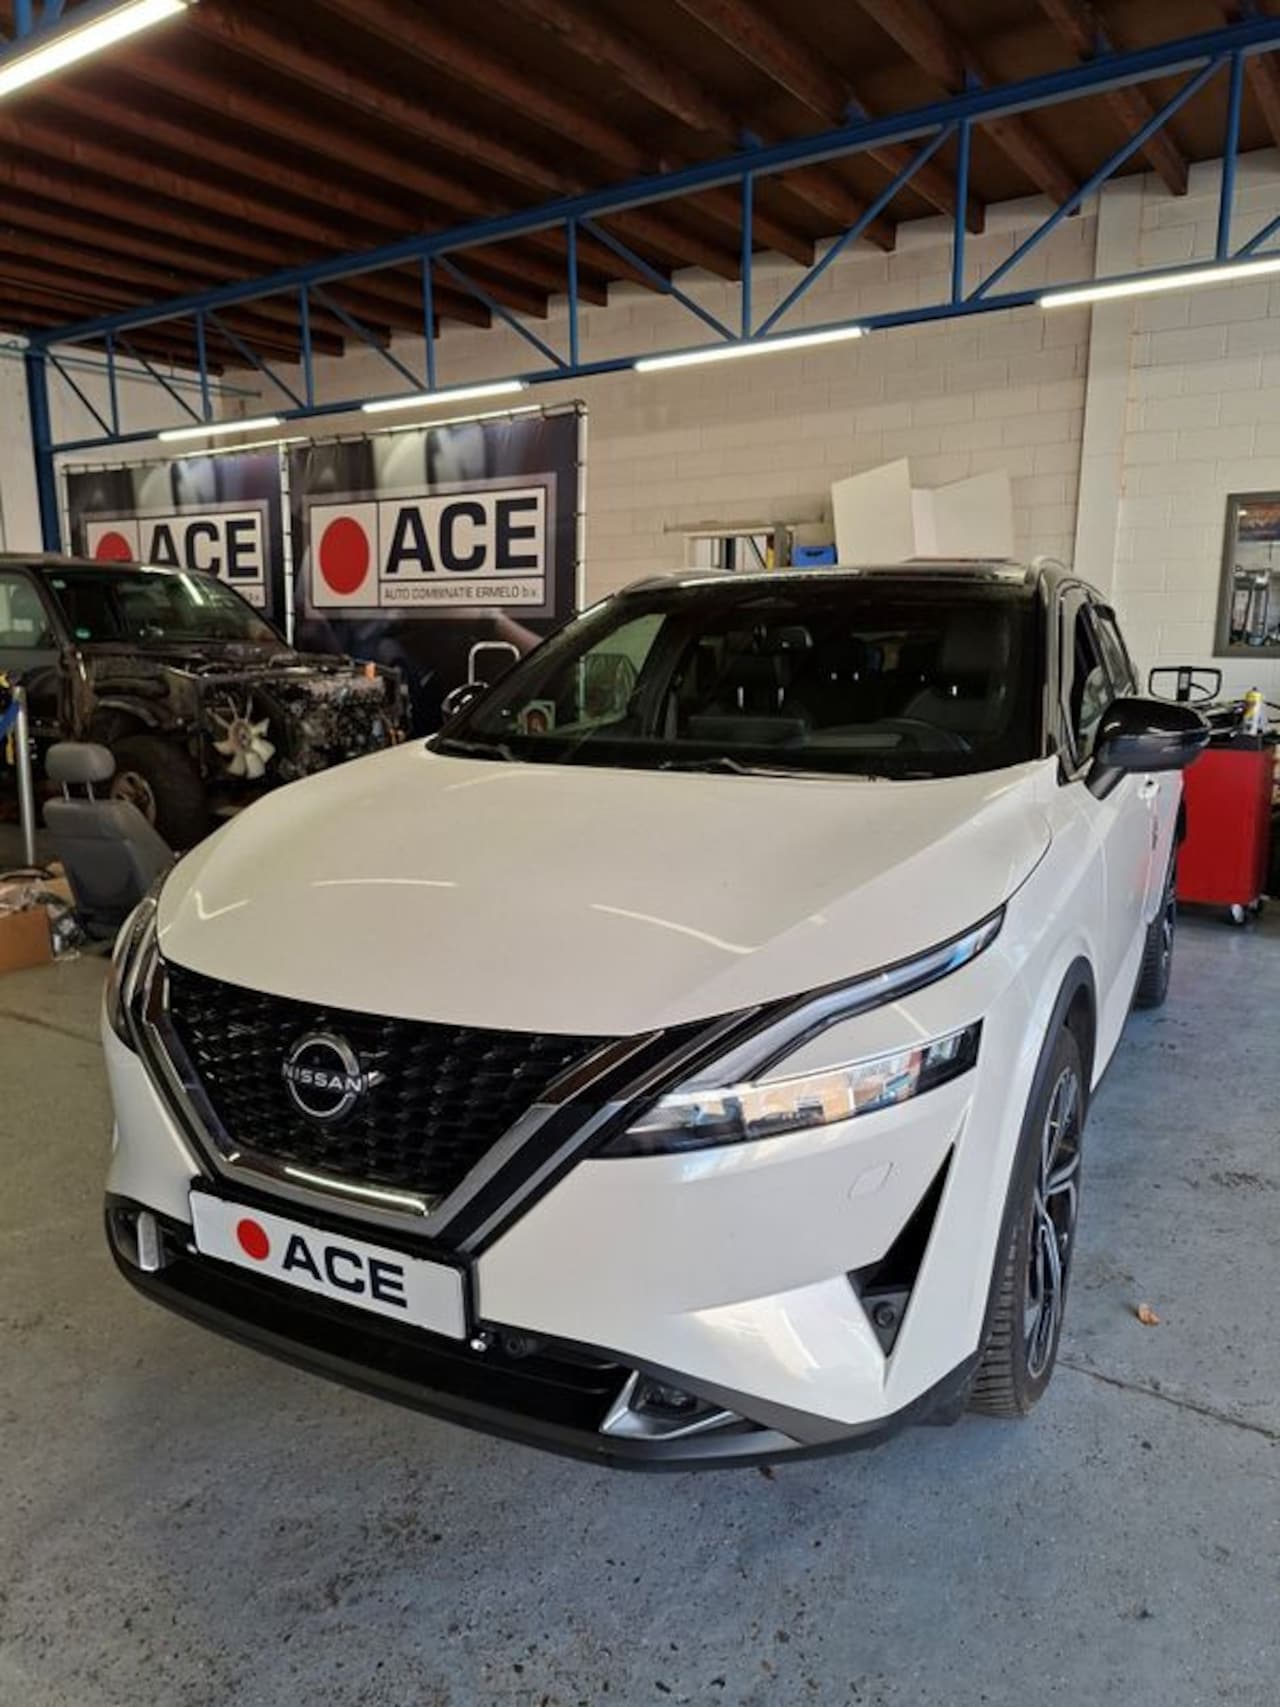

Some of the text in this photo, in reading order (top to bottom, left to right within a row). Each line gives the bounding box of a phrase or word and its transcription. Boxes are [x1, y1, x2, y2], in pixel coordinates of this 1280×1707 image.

[149, 519, 258, 579] ACE
[385, 497, 538, 574] ACE
[384, 587, 410, 601] AUTO
[475, 584, 520, 599] ERMELO
[282, 1062, 361, 1093] NISSAN
[282, 1234, 407, 1309] ACE
